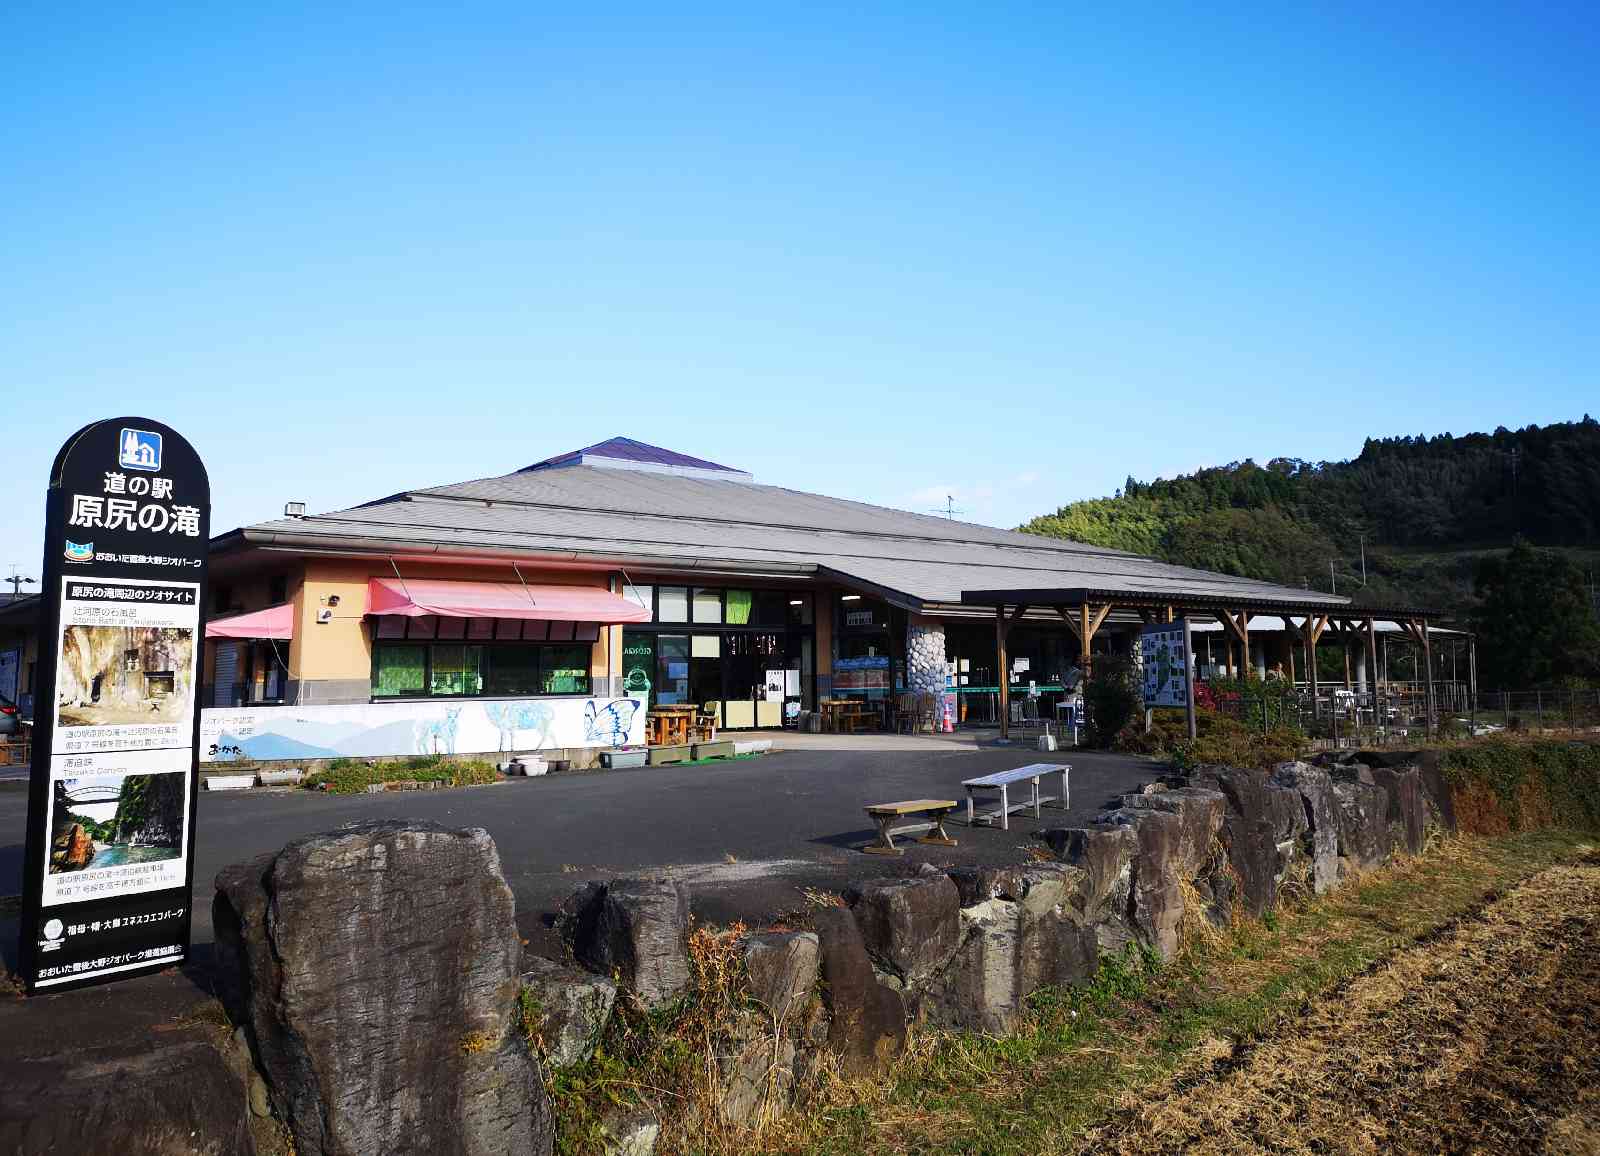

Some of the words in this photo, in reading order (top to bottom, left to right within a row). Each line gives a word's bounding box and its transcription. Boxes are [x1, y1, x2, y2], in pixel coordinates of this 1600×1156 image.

[104, 472, 173, 500] 道の駅
[69, 494, 201, 537] 原尻の滝
[95, 552, 202, 568] おおいた豊後大野ジオパーク
[72, 586, 193, 602] 原尻の滝周辺のジオサイト
